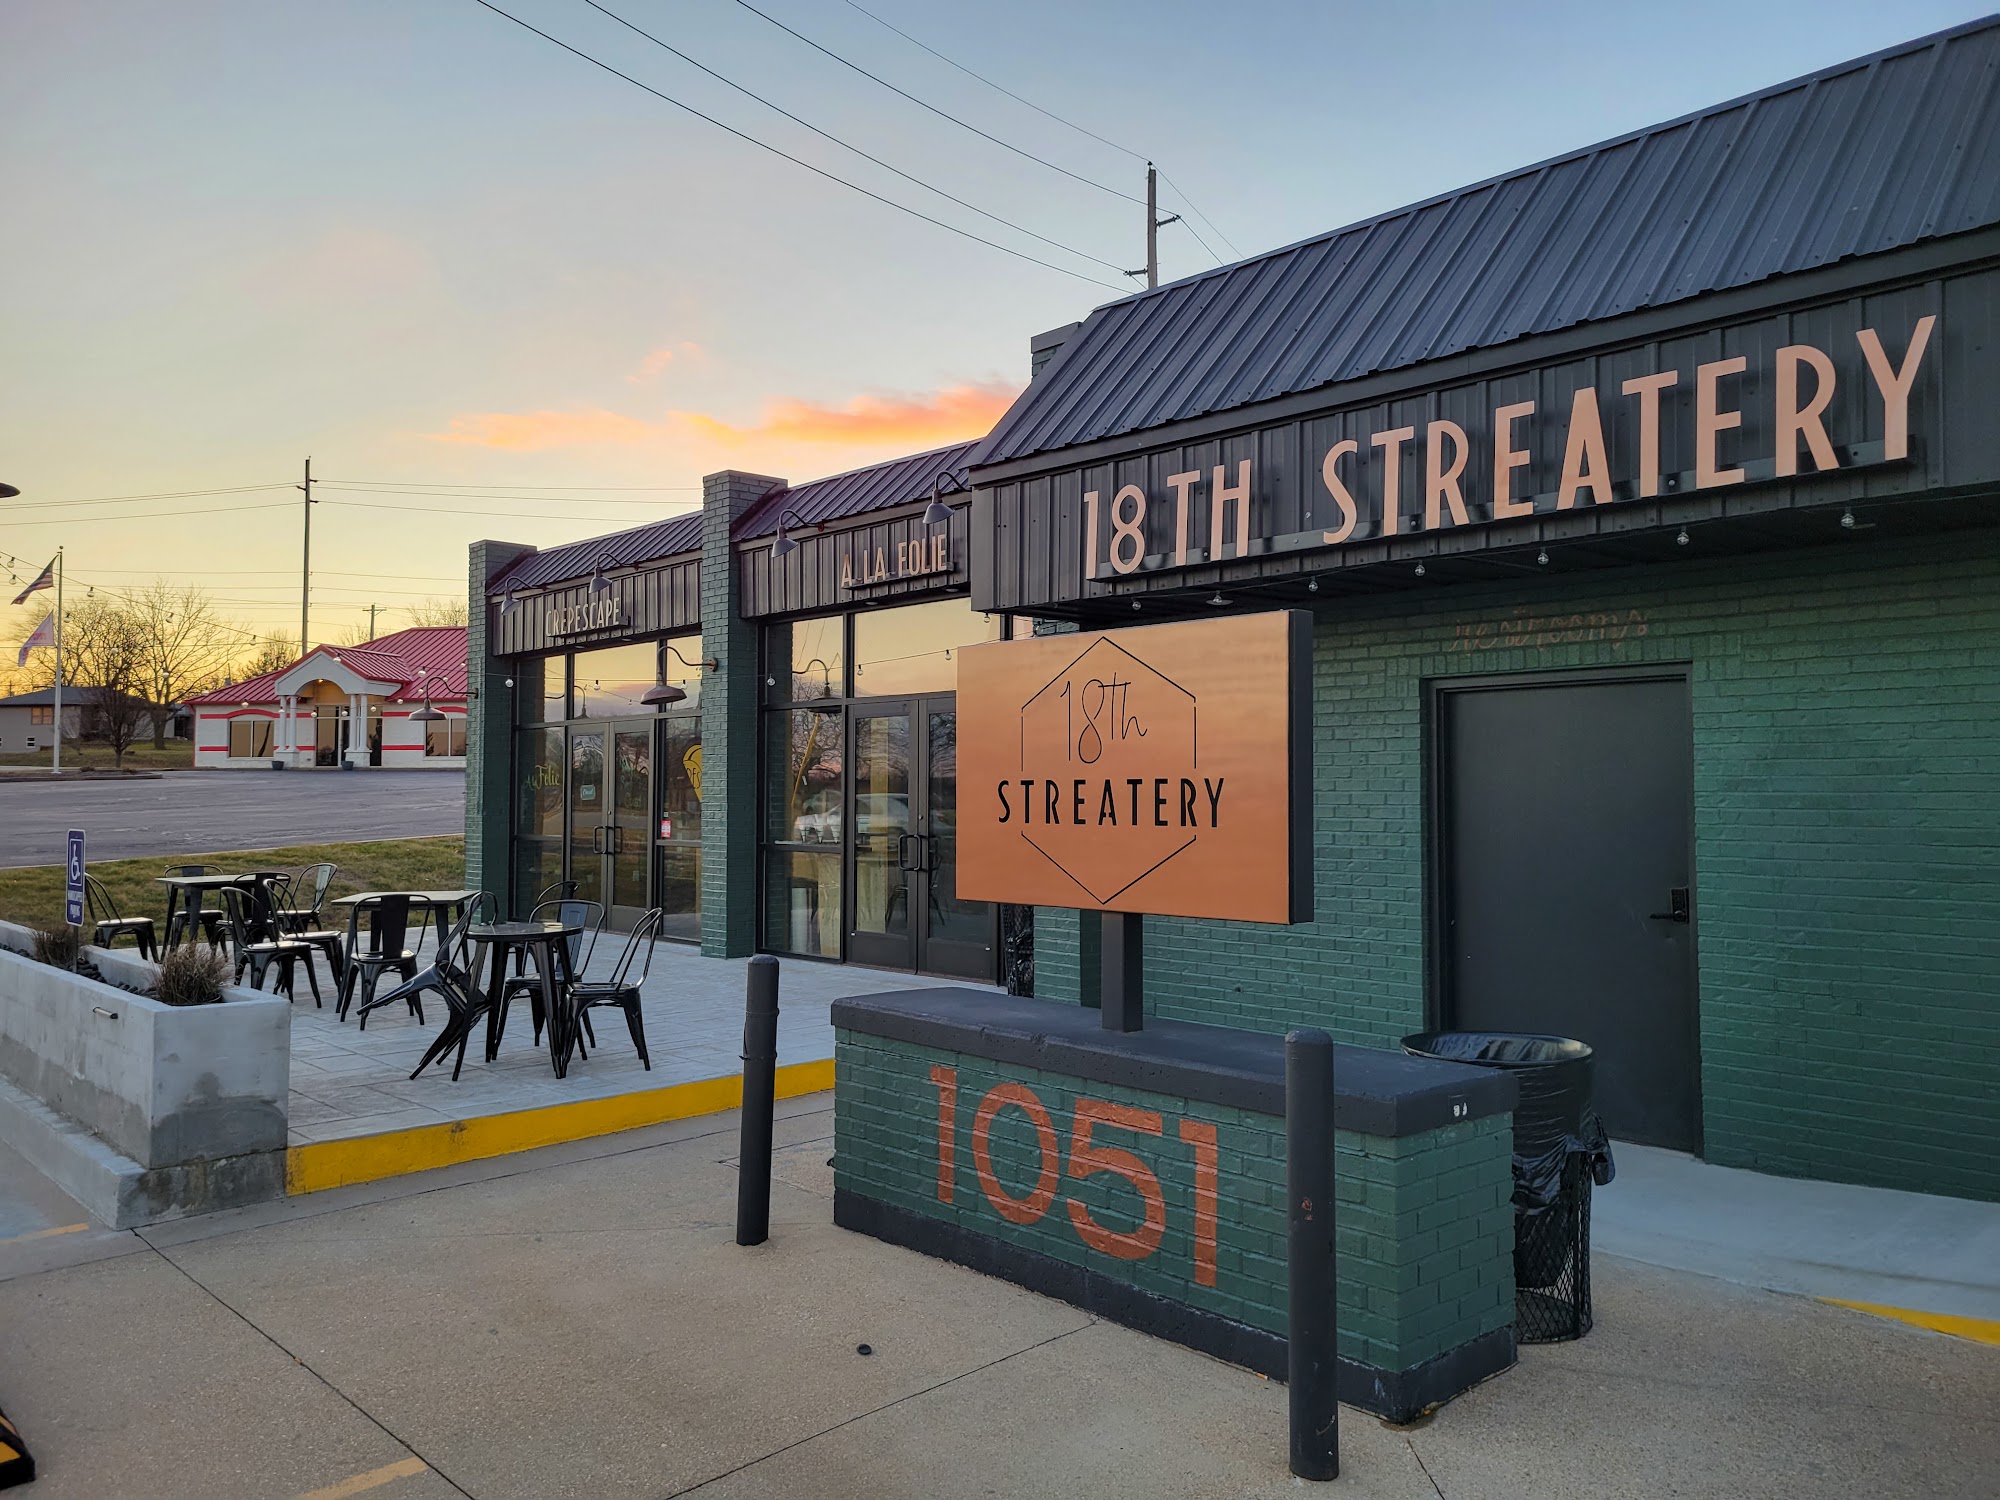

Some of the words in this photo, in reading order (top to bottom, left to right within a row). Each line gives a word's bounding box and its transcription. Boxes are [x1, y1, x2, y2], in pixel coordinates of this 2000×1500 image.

[1084, 459, 1251, 579] 18TH
[1322, 315, 1937, 545] STREATERY
[841, 554, 852, 588] A
[863, 549, 886, 584] LA
[898, 534, 946, 578] FOLIE
[546, 597, 619, 636] CREPESCAPE
[1060, 672, 1148, 764] 18th
[997, 778, 1224, 828] STREATERY
[930, 1065, 1218, 1287] 1051
